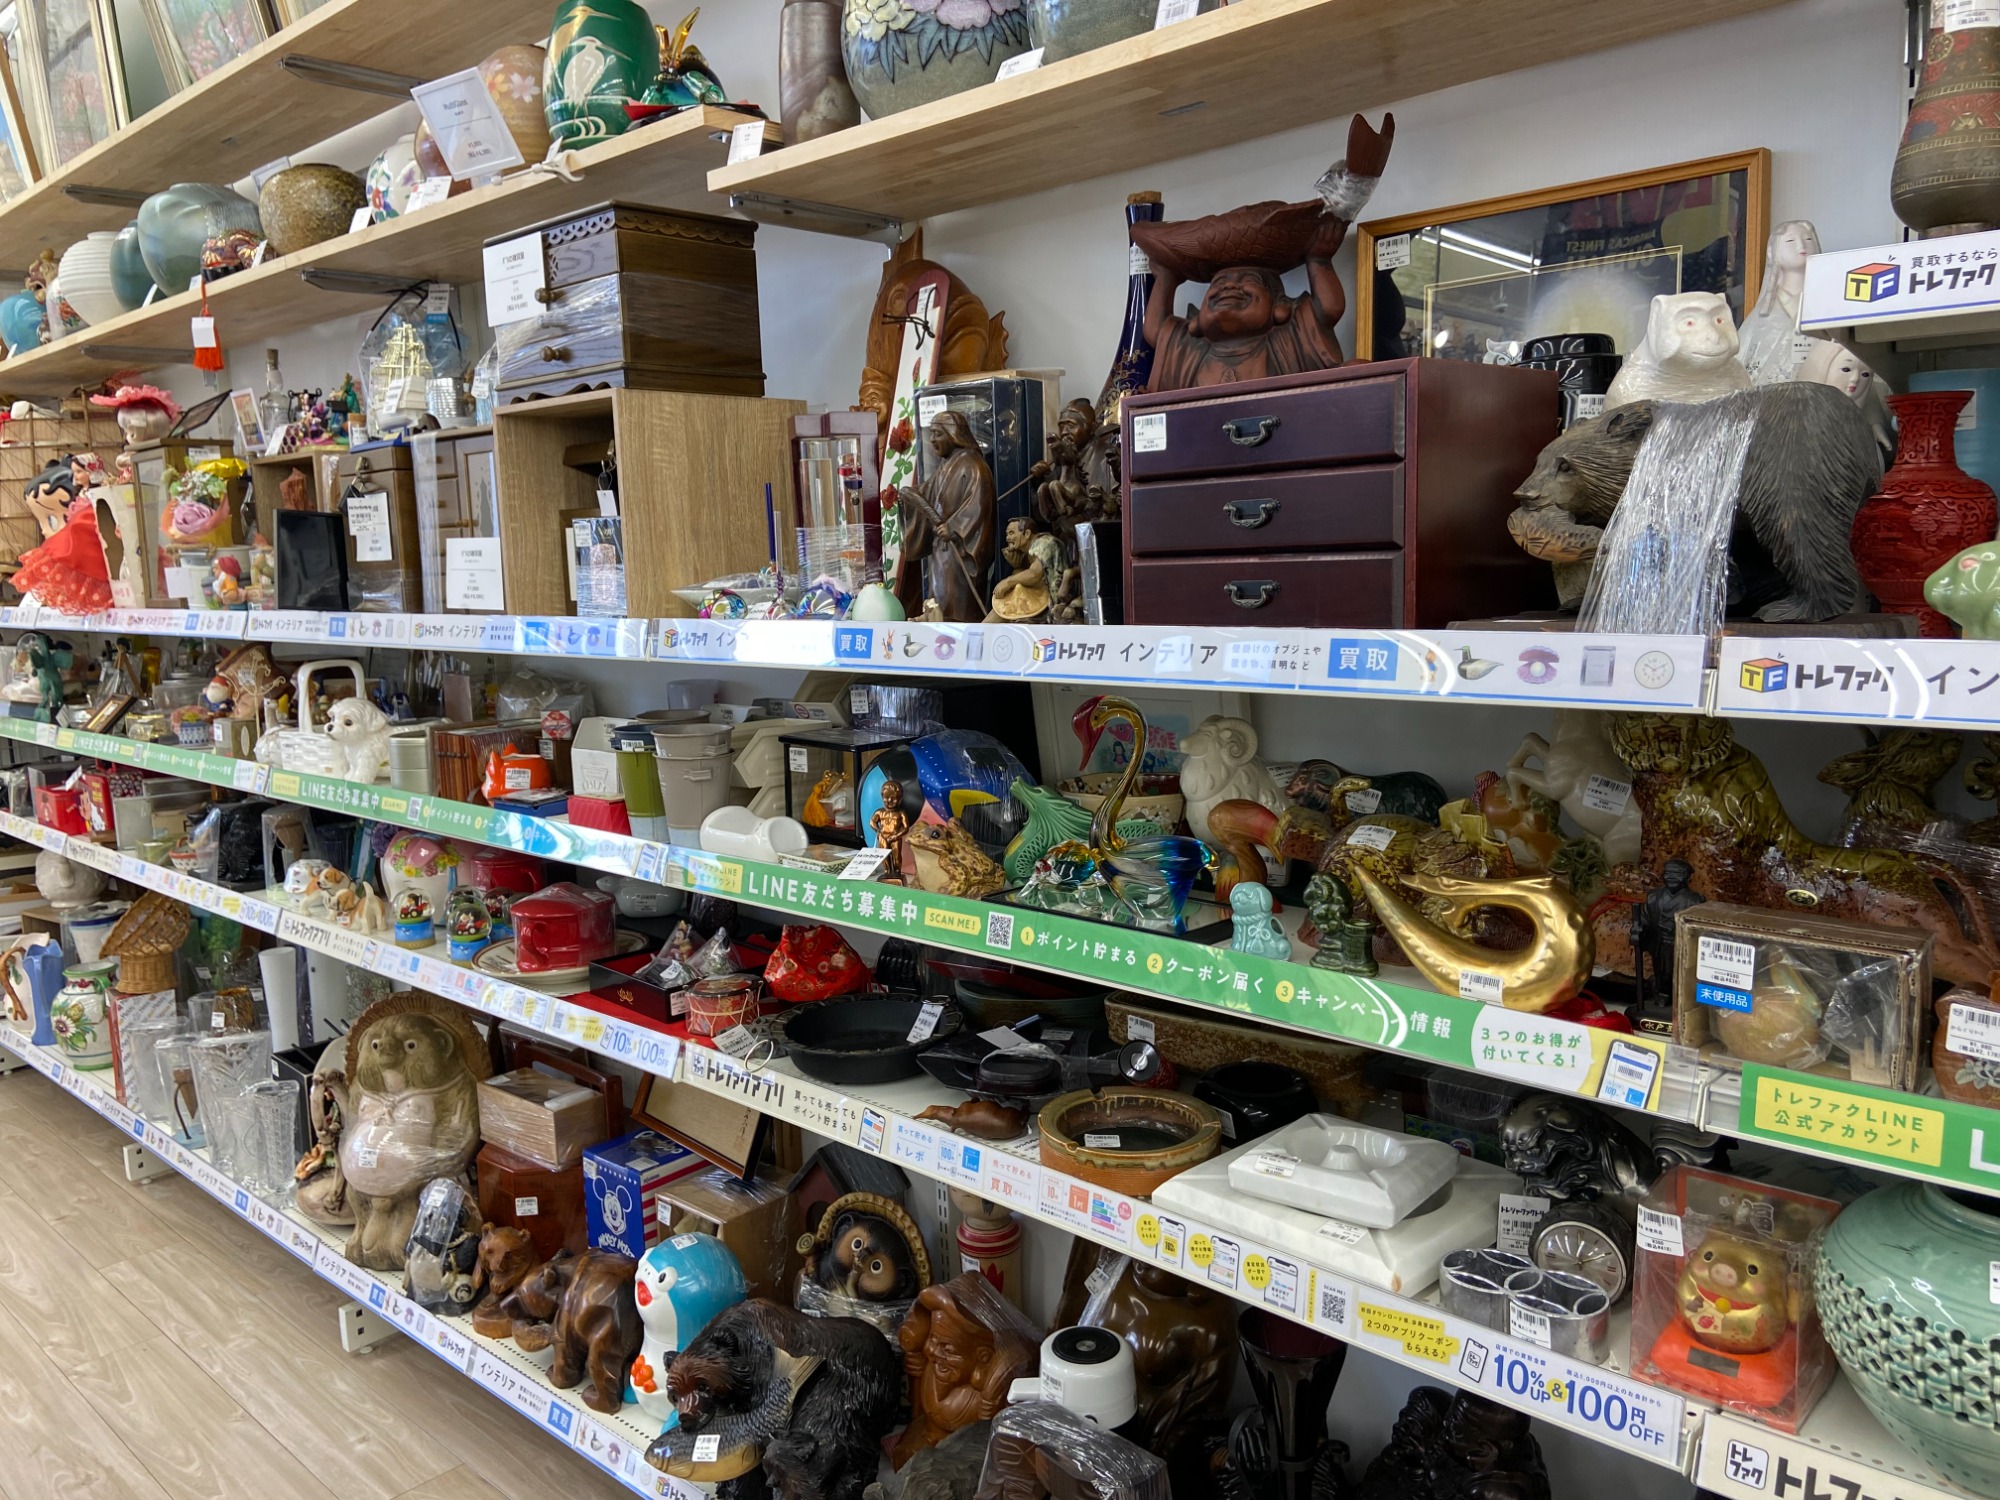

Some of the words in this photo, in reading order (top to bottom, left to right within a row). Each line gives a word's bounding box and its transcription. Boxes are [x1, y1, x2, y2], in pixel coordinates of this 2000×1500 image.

[1911, 248, 1998, 269] 買取するなら
[1909, 263, 1996, 294] トレファク
[448, 625, 486, 639] インテリア
[839, 634, 868, 652] 買取
[1058, 642, 1106, 662] トレファク
[1119, 642, 1218, 665] インテリア
[1232, 643, 1322, 656] 壁掛けのオブジェや
[1339, 647, 1388, 672] 買取
[1795, 664, 1895, 692] トレファク
[301, 780, 379, 810] LINE友だち募集中
[748, 871, 918, 926] LINE友だち募集中
[929, 913, 955, 927] SCAN
[956, 918, 975, 930] ME!
[1037, 931, 1136, 966] ポイント貯まる
[1166, 957, 1264, 994] クーポン届く
[1700, 987, 1748, 1008] 未使用品
[1482, 1027, 1582, 1050] 3つのお得が
[706, 1058, 785, 1108] トレファクアプリ
[794, 1089, 856, 1120] 買っても売っても
[1774, 1086, 1924, 1132] トレファクLINE
[1774, 1109, 1921, 1154] 公式アカウント
[896, 1143, 925, 1162] トレポ
[1367, 1319, 1453, 1347] 2つのアプリクーポン
[480, 1362, 516, 1391] インテリア
[1629, 1423, 1665, 1446] OFF
[1730, 1443, 1753, 1463] トレ
[1729, 1460, 1764, 1485] ファク
